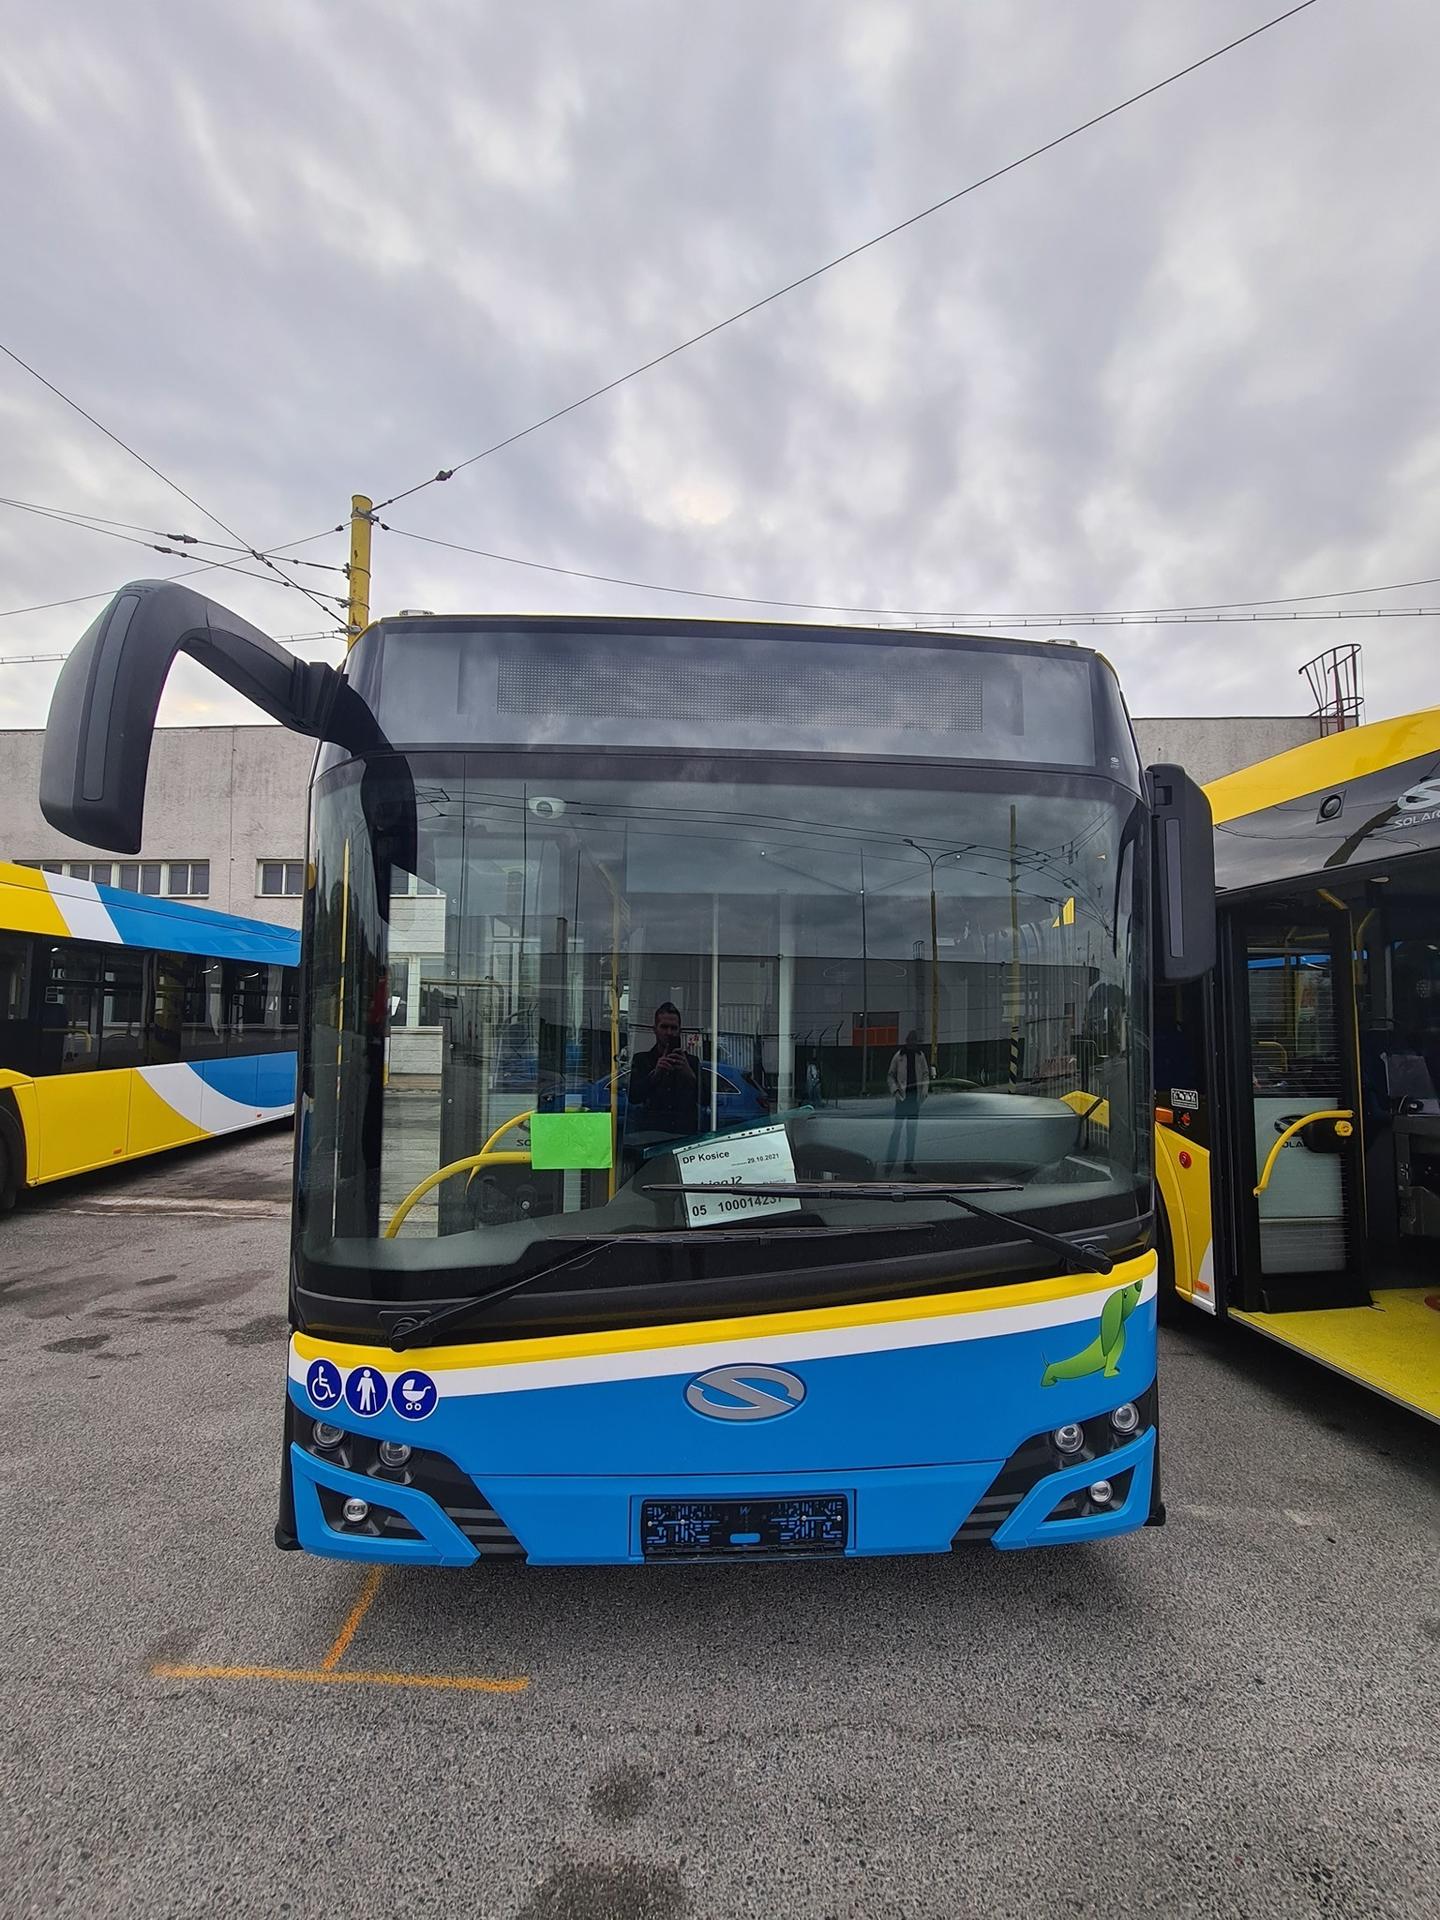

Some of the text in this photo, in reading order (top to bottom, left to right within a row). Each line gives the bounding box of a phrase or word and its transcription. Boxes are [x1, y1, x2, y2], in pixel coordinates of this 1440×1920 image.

[682, 1151, 730, 1164] DP Kosice
[747, 1153, 780, 1164] 29.10.2021
[692, 1205, 707, 1217] 05
